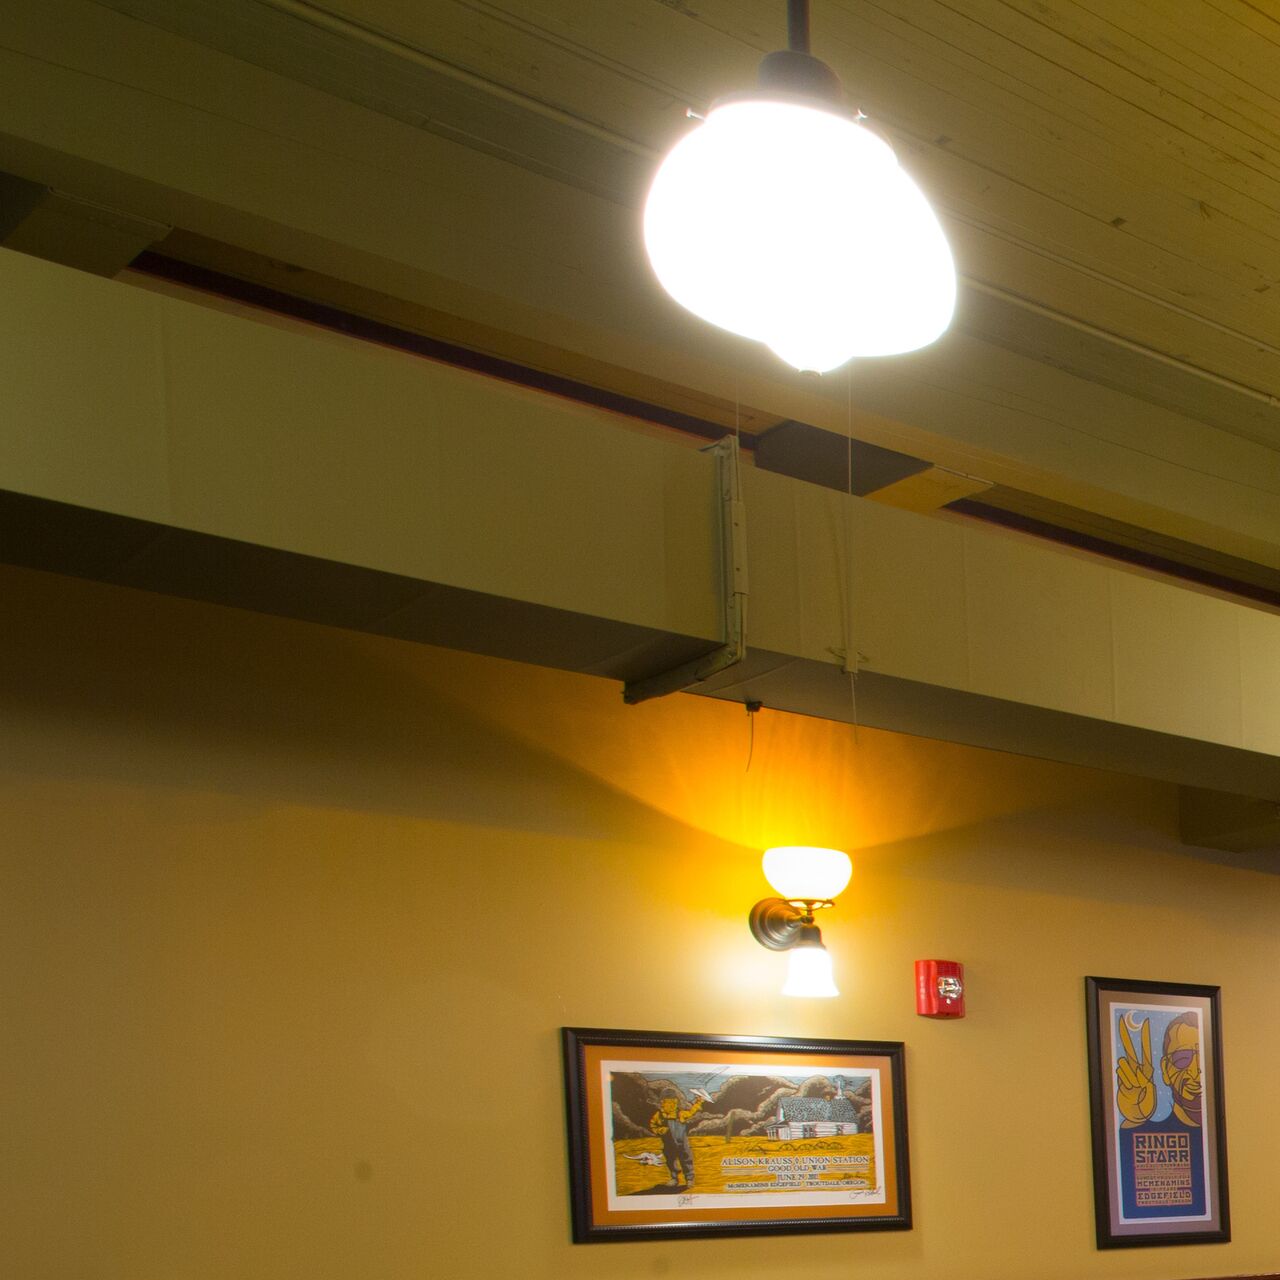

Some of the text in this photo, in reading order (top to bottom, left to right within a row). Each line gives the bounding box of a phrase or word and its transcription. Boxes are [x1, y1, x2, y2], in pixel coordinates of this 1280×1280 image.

[1135, 1135, 1188, 1149] RINGO
[722, 1157, 755, 1166] ALISON
[758, 1156, 793, 1165] KRAUSS
[802, 1156, 830, 1164] UNION
[833, 1155, 869, 1164] STATION
[1136, 1150, 1189, 1163] STARR
[794, 1164, 809, 1172] OLD
[1138, 1191, 1191, 1200] EDGEFIELD
